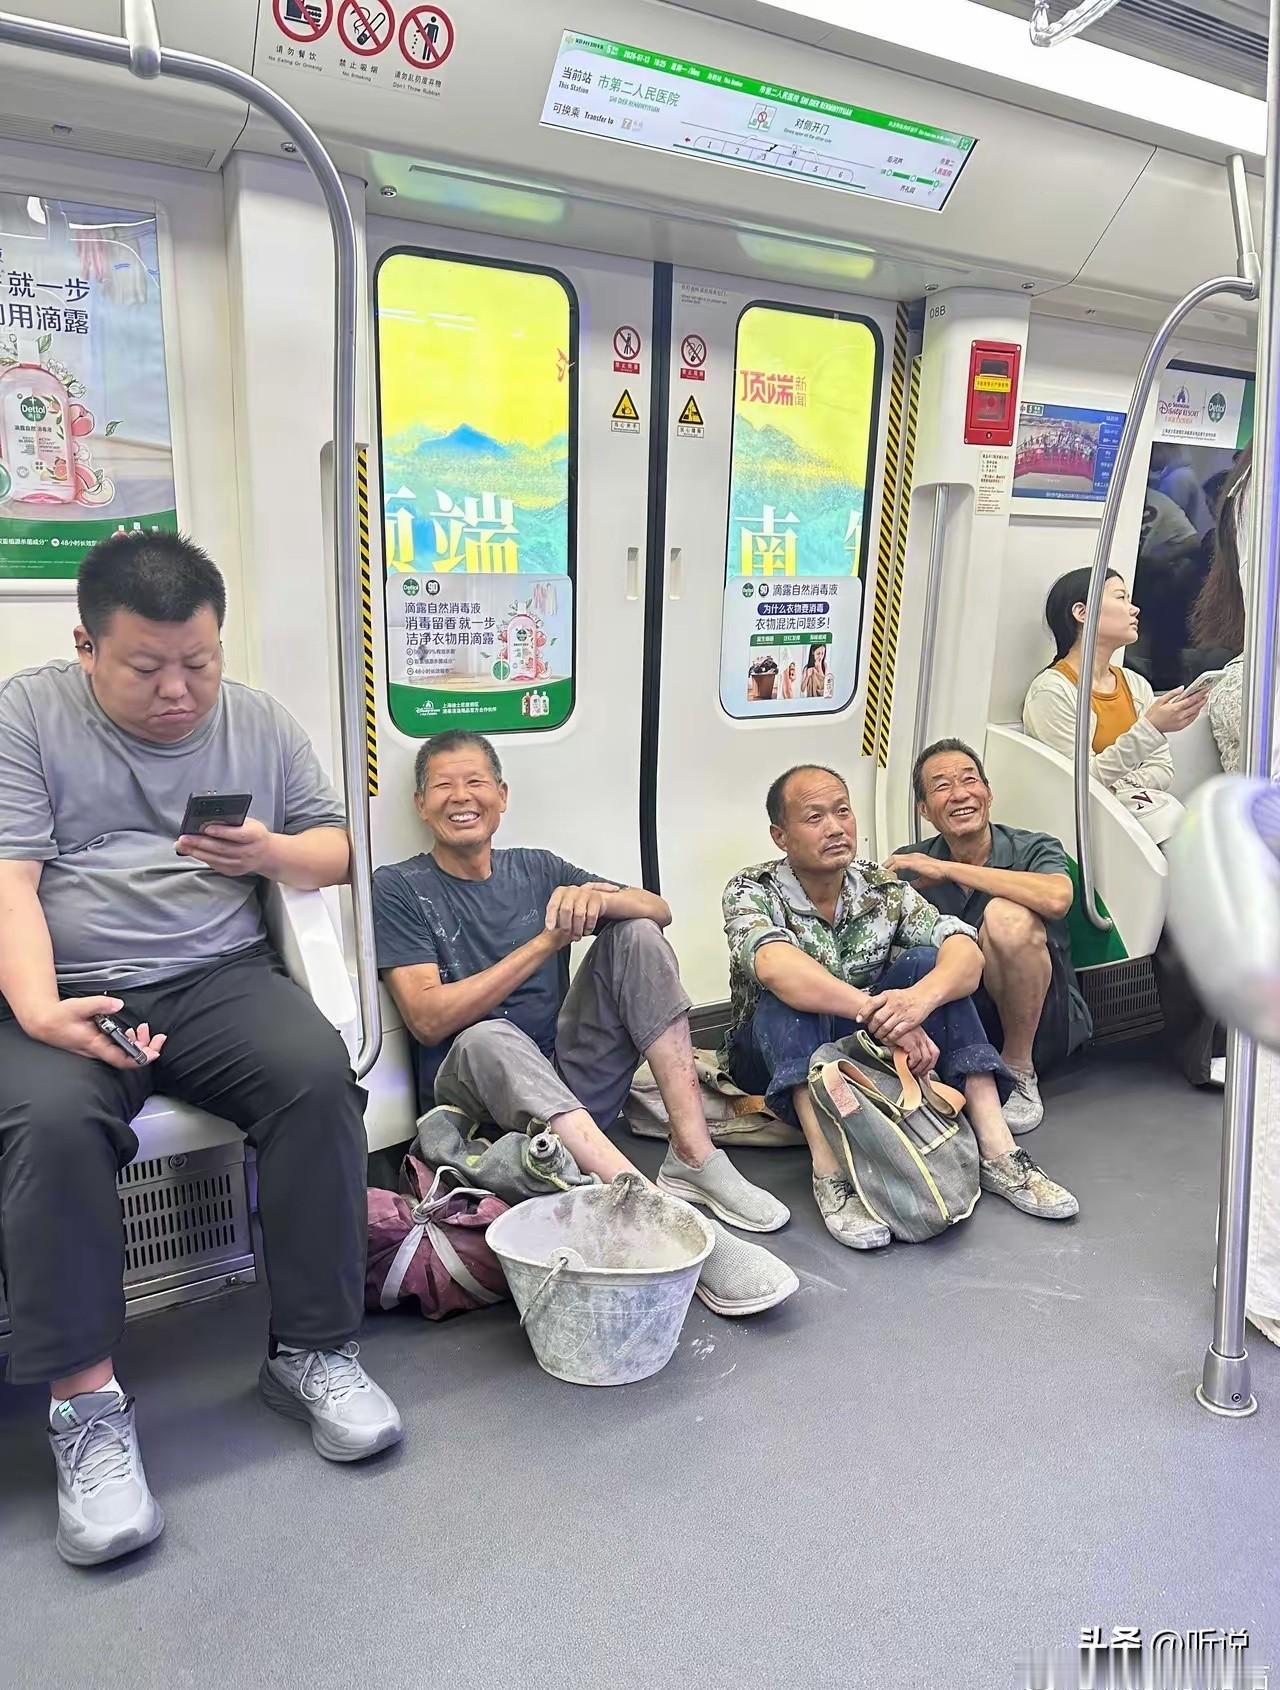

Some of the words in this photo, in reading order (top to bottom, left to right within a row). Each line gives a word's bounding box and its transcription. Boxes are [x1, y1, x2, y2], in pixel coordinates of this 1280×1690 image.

[339, 58, 379, 74] 禁止吸烟
[562, 66, 592, 84] 当前站
[558, 81, 569, 90] This
[570, 84, 589, 95] Station
[598, 74, 680, 107] 市第二人民医院
[553, 102, 581, 118] 可换乘
[584, 111, 607, 124] Transfer
[795, 117, 830, 136] 对侧开门
[8, 271, 90, 302] 就一步
[0, 303, 89, 334] 用滴露
[930, 304, 946, 319] 08B
[740, 370, 794, 406] 顶端
[21, 404, 46, 414] Dettol
[772, 583, 838, 596] 滴露自然消毒液
[405, 602, 481, 614] 滴露自然消毒液
[763, 603, 824, 614] 为什么衣物要消毒
[405, 616, 456, 630] 消毒留香
[459, 617, 496, 630] 就一步
[406, 632, 495, 646] 洁净衣物用滴露
